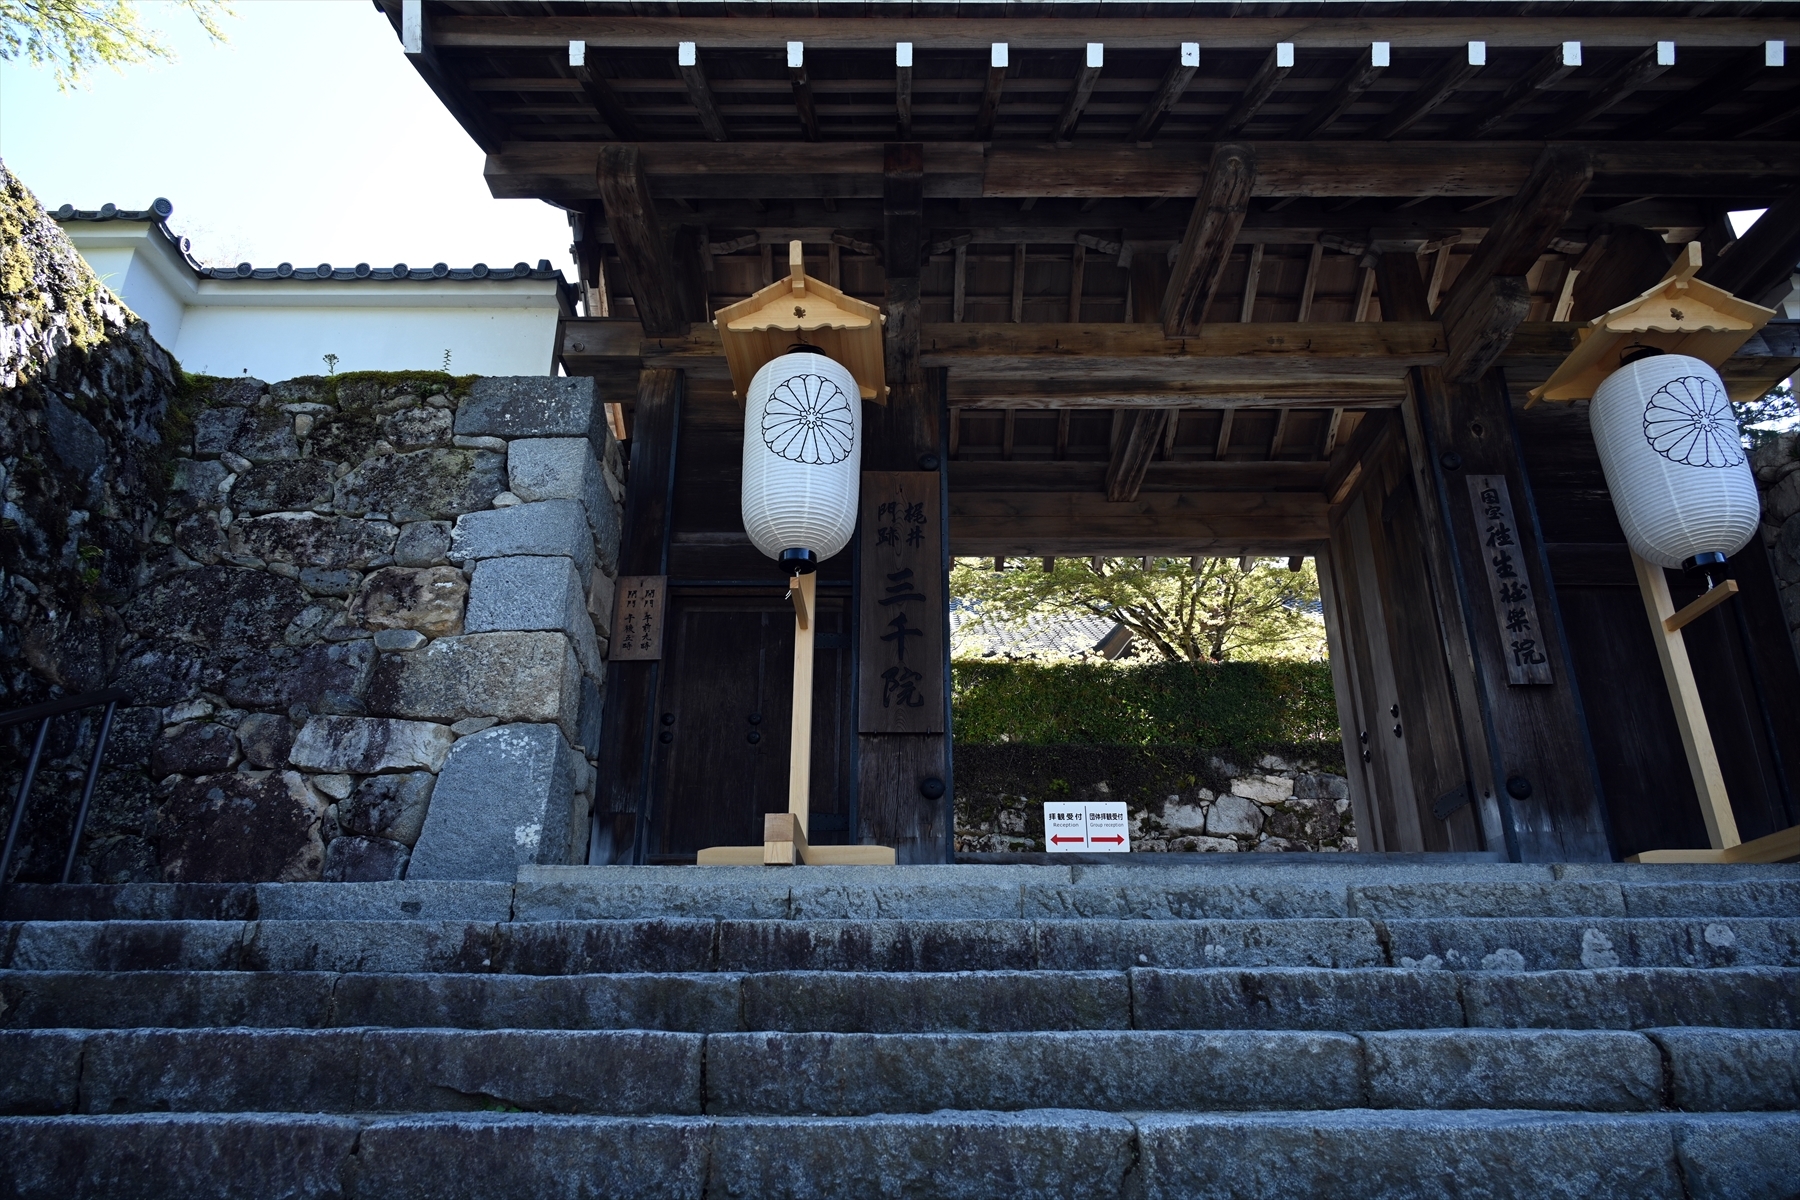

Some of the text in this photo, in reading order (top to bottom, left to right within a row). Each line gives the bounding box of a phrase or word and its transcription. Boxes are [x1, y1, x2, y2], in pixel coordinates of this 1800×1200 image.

[875, 502, 899, 547] 門跡
[904, 502, 927, 549] 梶井
[878, 567, 926, 708] 三千院
